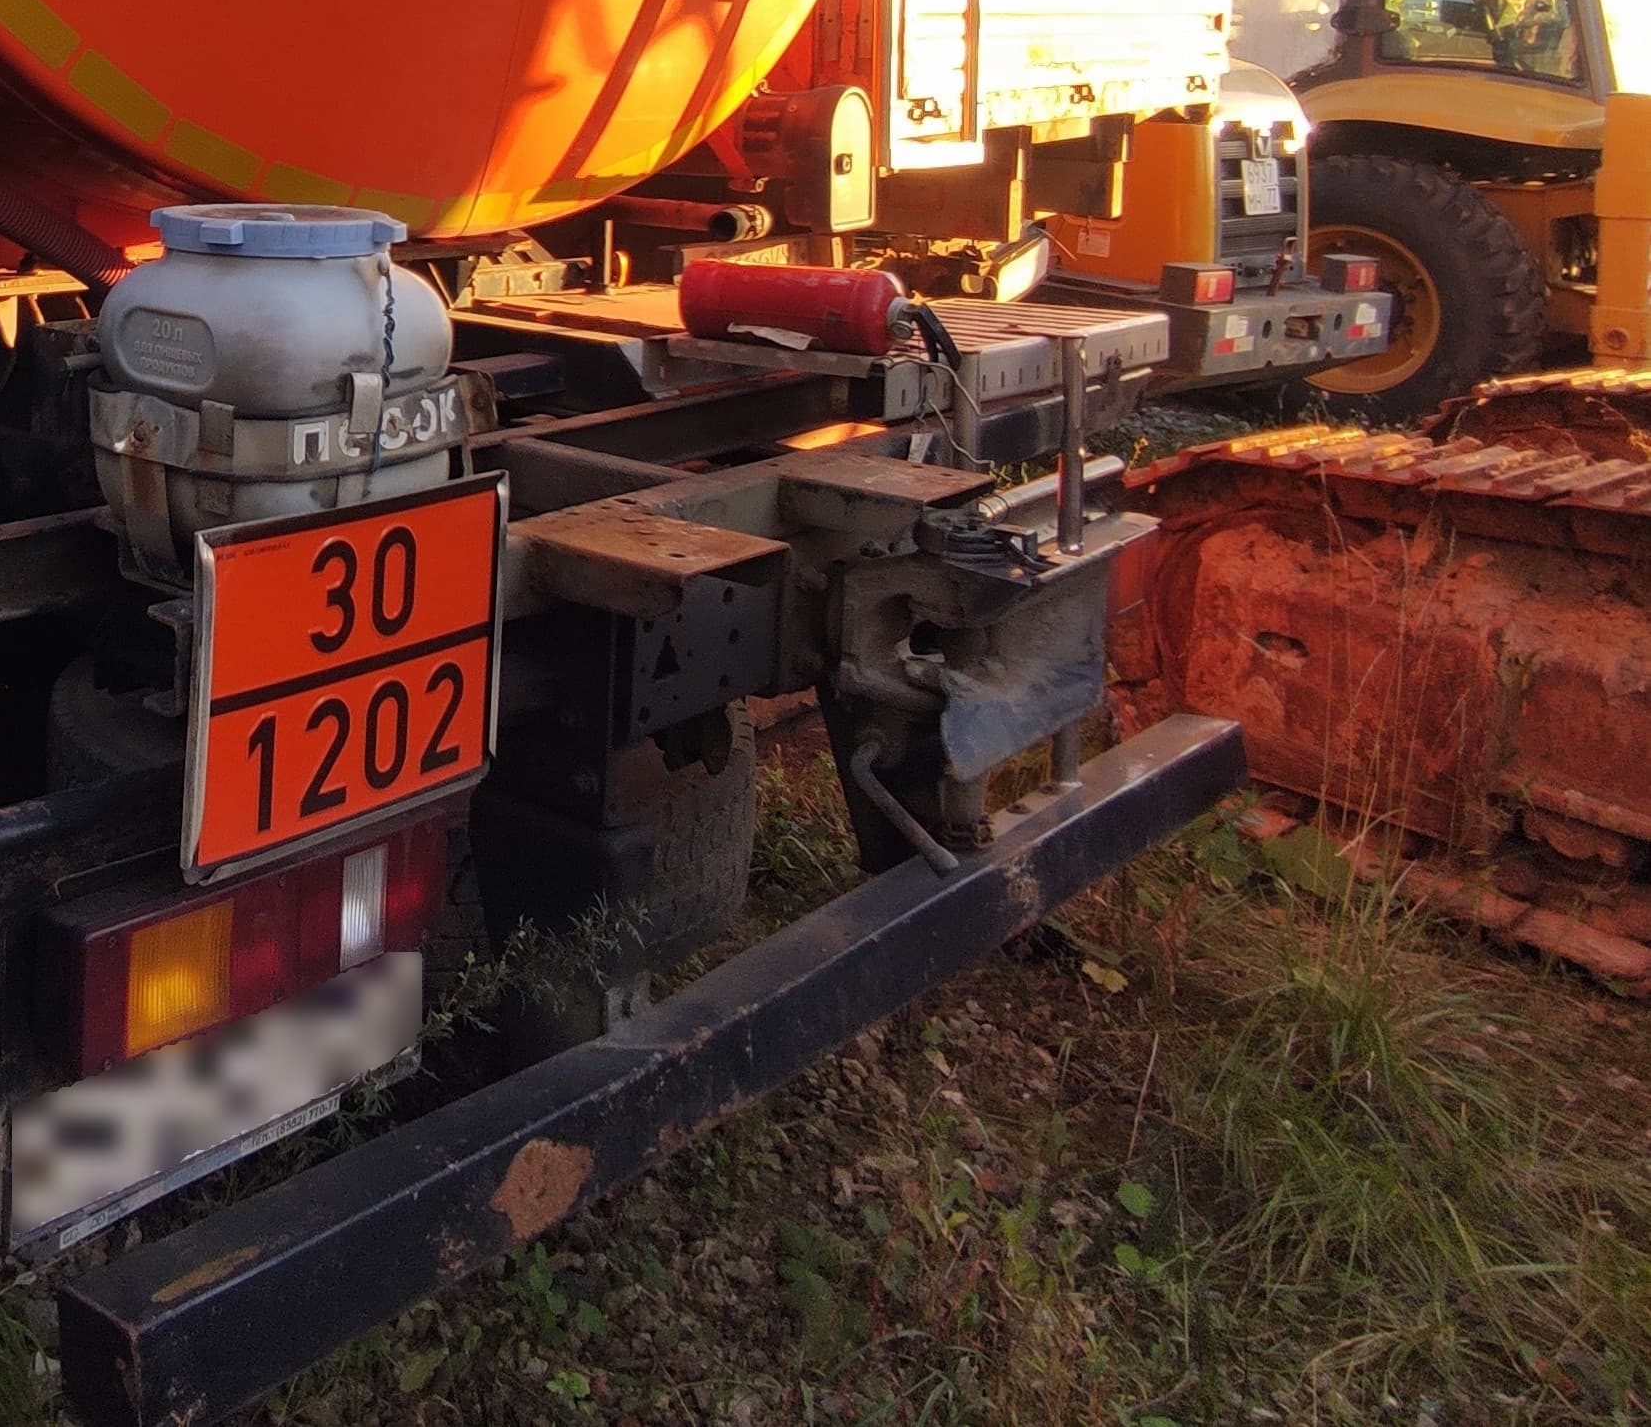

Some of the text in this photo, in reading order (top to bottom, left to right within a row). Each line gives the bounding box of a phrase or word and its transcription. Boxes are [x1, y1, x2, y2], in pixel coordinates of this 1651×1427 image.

[151, 317, 170, 339] 20
[309, 525, 417, 654] 30
[246, 661, 466, 834] 1202
